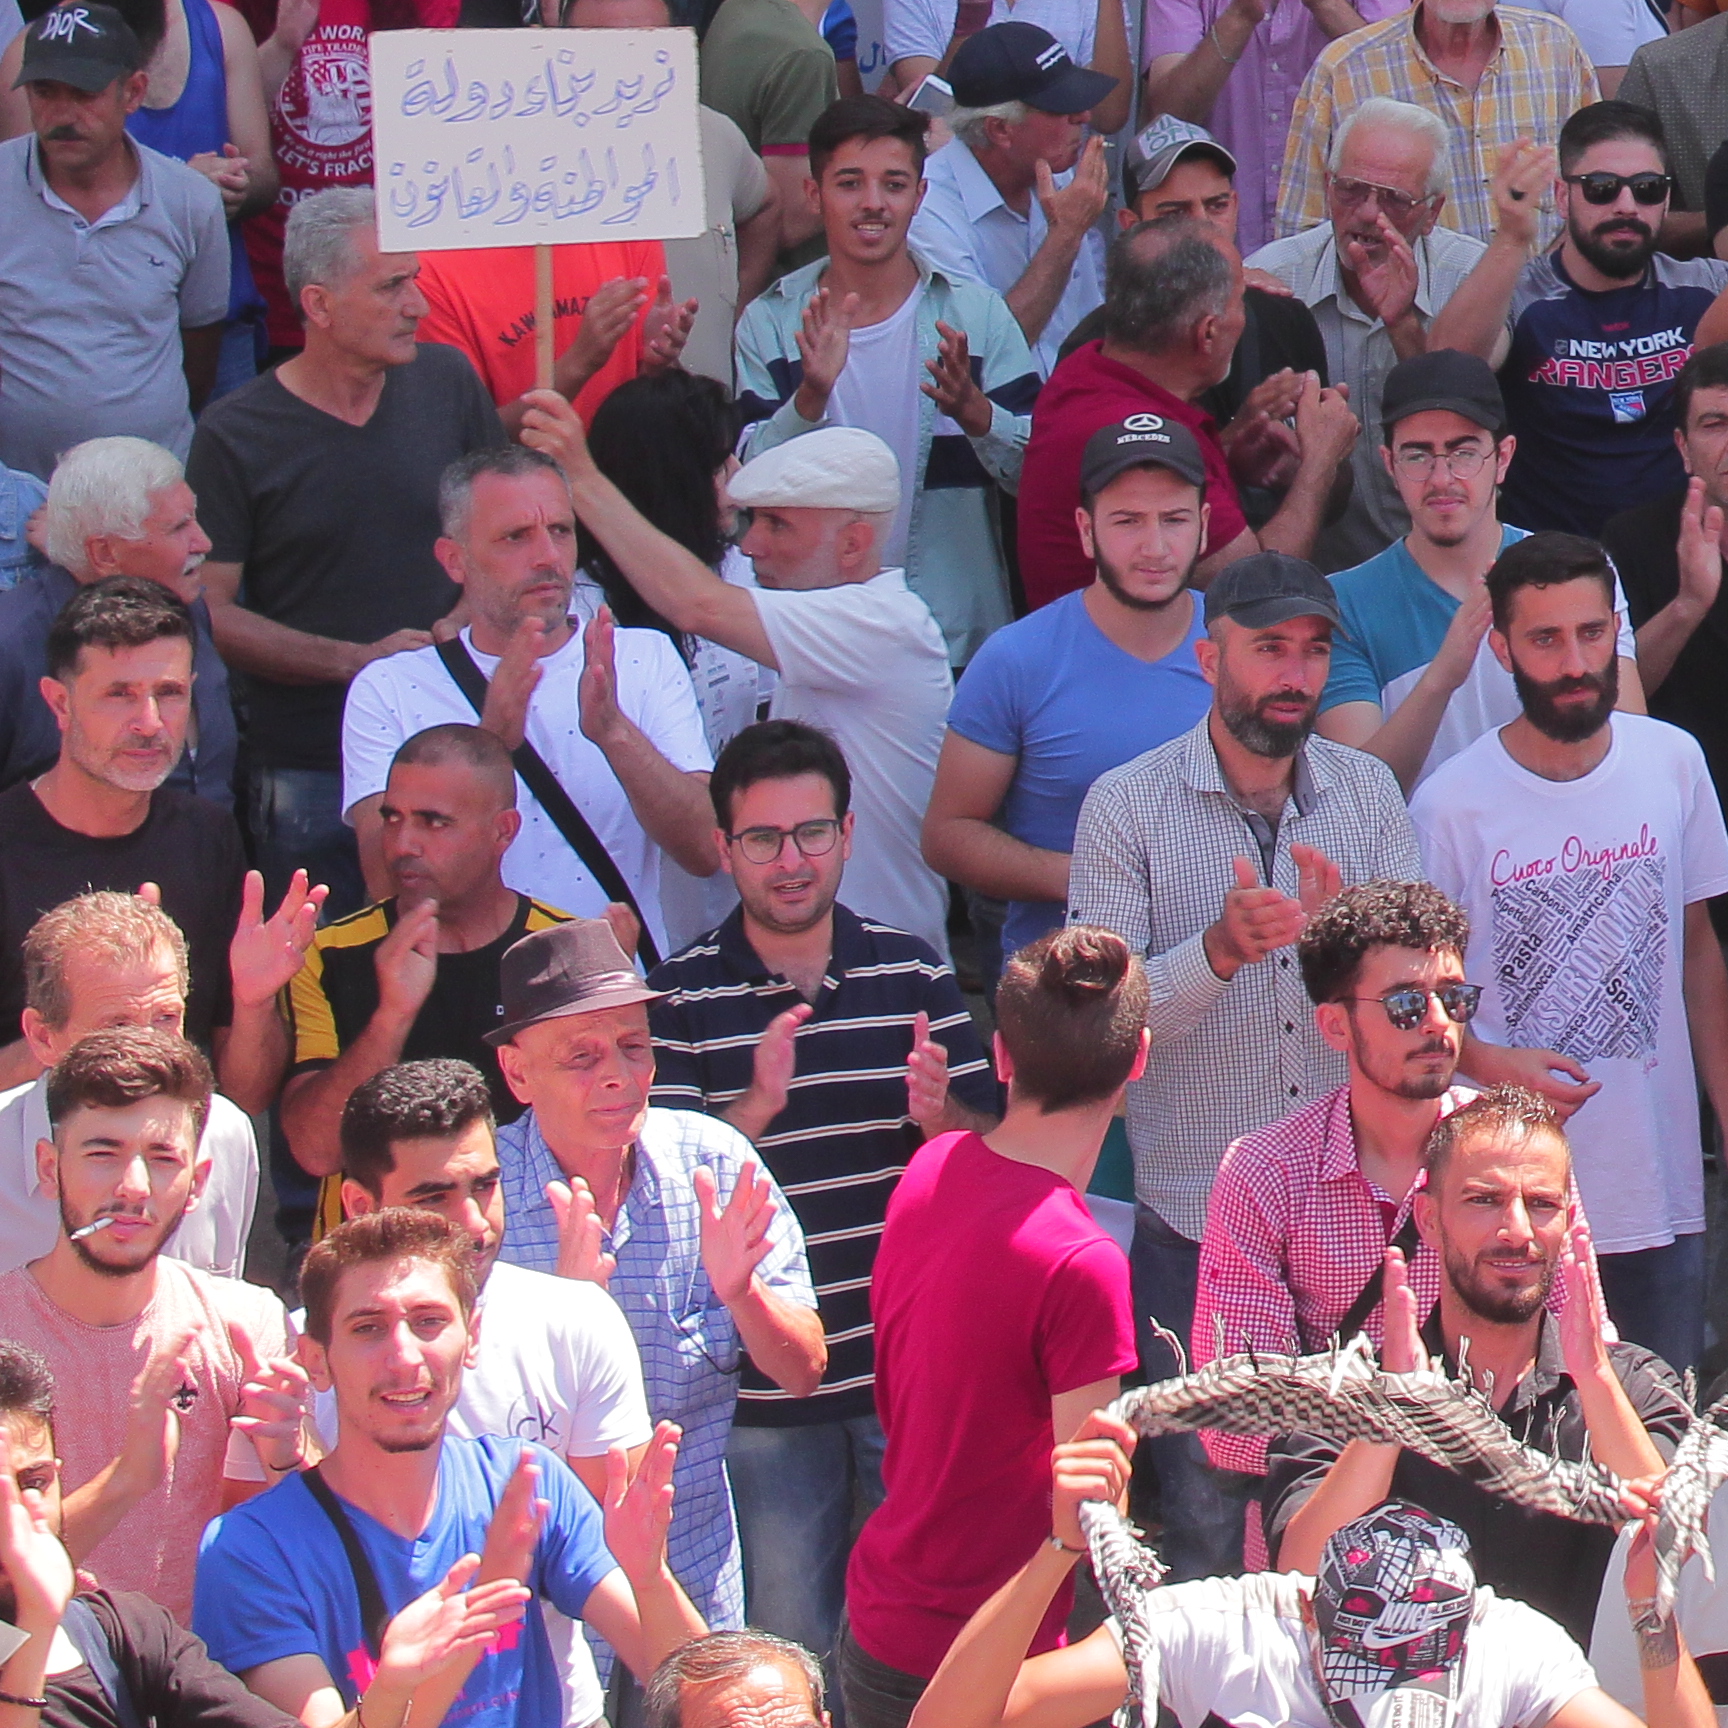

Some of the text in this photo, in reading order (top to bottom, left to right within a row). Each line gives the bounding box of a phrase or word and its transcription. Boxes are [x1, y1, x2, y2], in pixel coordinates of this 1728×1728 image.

[37, 6, 101, 44] DIOR
[319, 24, 367, 43] WOR
[401, 48, 675, 129] نريد بناء دولة
[324, 153, 373, 178] FRAC
[389, 141, 682, 229] المواطنة والقانون
[1528, 343, 1697, 391] RANGER
[1567, 326, 1687, 359] NEW YORK
[1490, 822, 1660, 887] Cuoco Originale
[1565, 871, 1623, 946] Amatriciana
[1500, 932, 1544, 981] Pasta
[1504, 963, 1558, 1028] Saltimbocca
